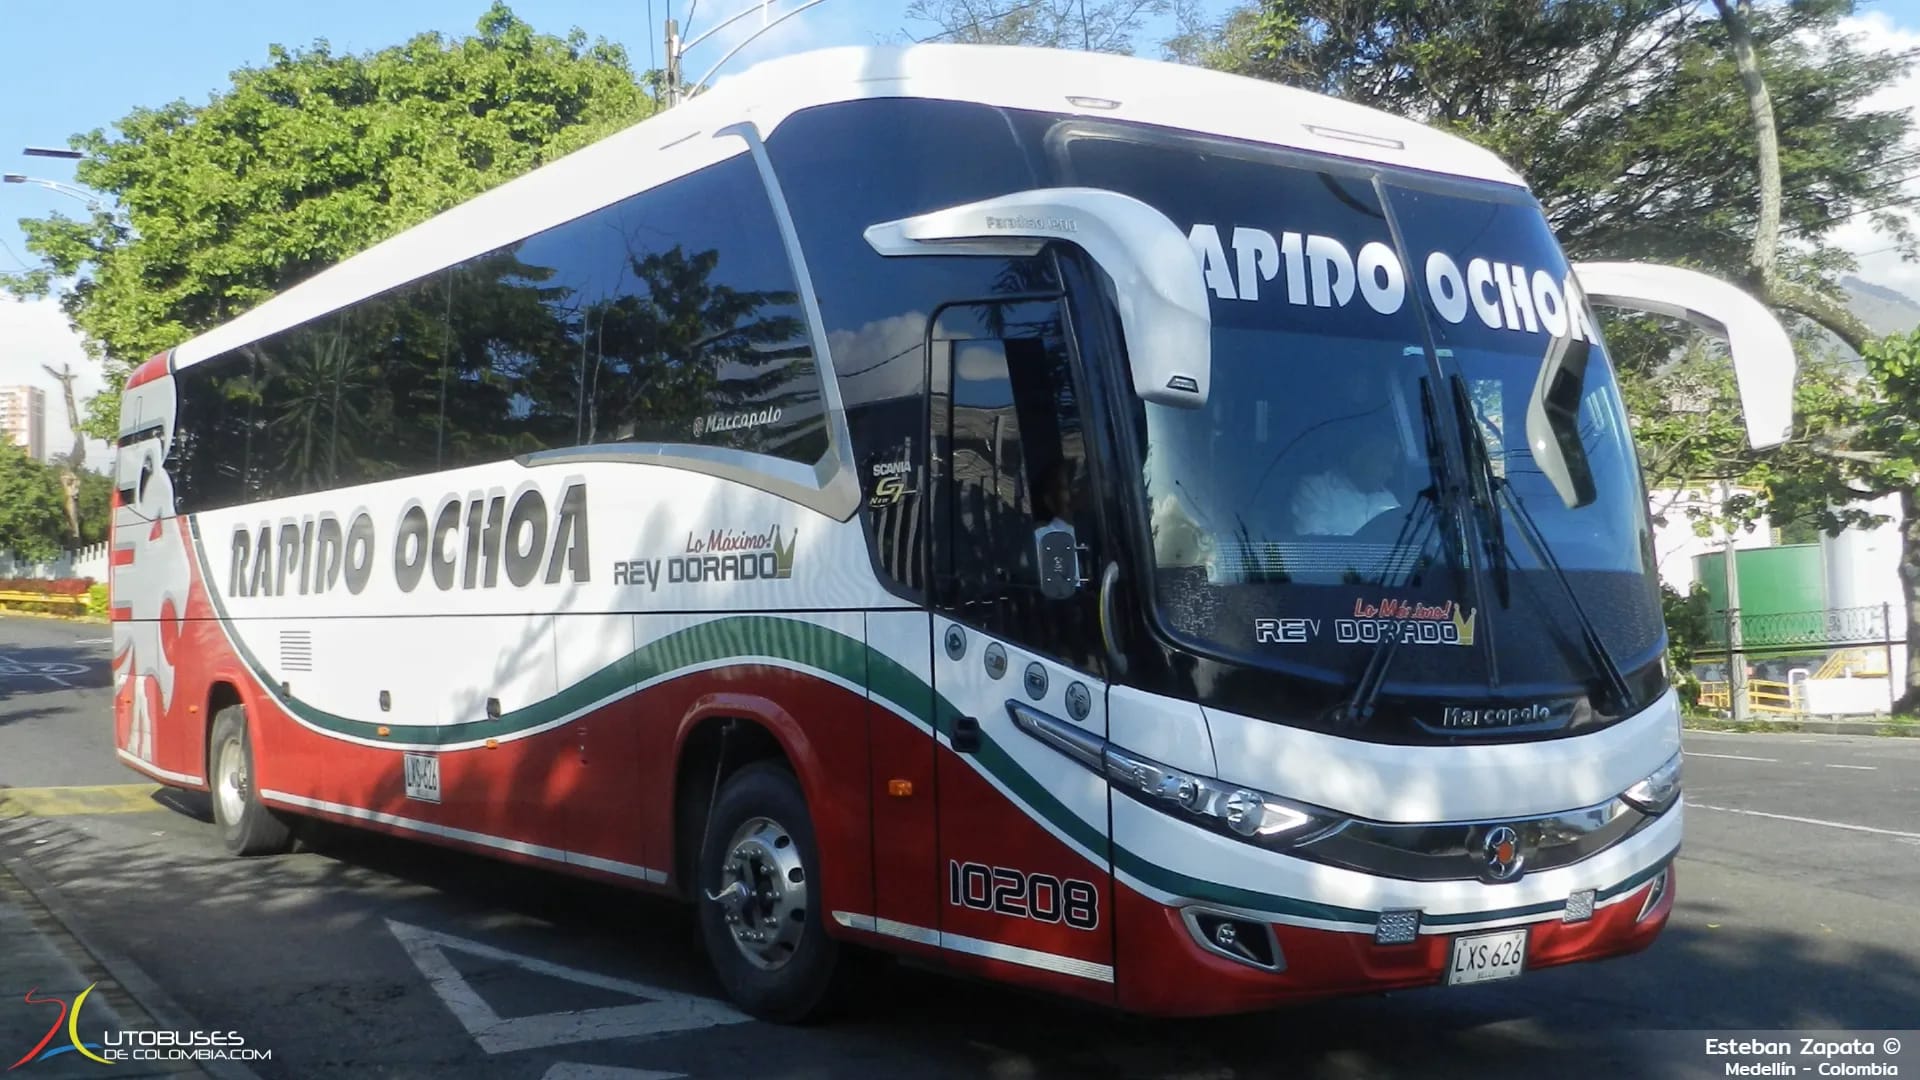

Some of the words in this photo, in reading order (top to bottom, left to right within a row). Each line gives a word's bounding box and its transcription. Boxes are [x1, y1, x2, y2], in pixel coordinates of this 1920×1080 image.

[1188, 223, 1406, 316] APIDO
[1425, 251, 1600, 347] OCHOA
[705, 406, 782, 433] Marcopolo
[873, 461, 911, 477] SCANIA
[229, 506, 376, 597] RAPIDO
[393, 475, 591, 594] OCHOA
[686, 531, 705, 553] Lo
[613, 559, 662, 592] REY
[668, 552, 778, 584] DORADO
[1354, 598, 1379, 618] Lo
[1379, 599, 1452, 620] Máimo!
[1443, 703, 1551, 727] Marcopolo
[950, 859, 1099, 931] 10208
[1455, 944, 1488, 972] LXS
[1491, 939, 1522, 967] 626
